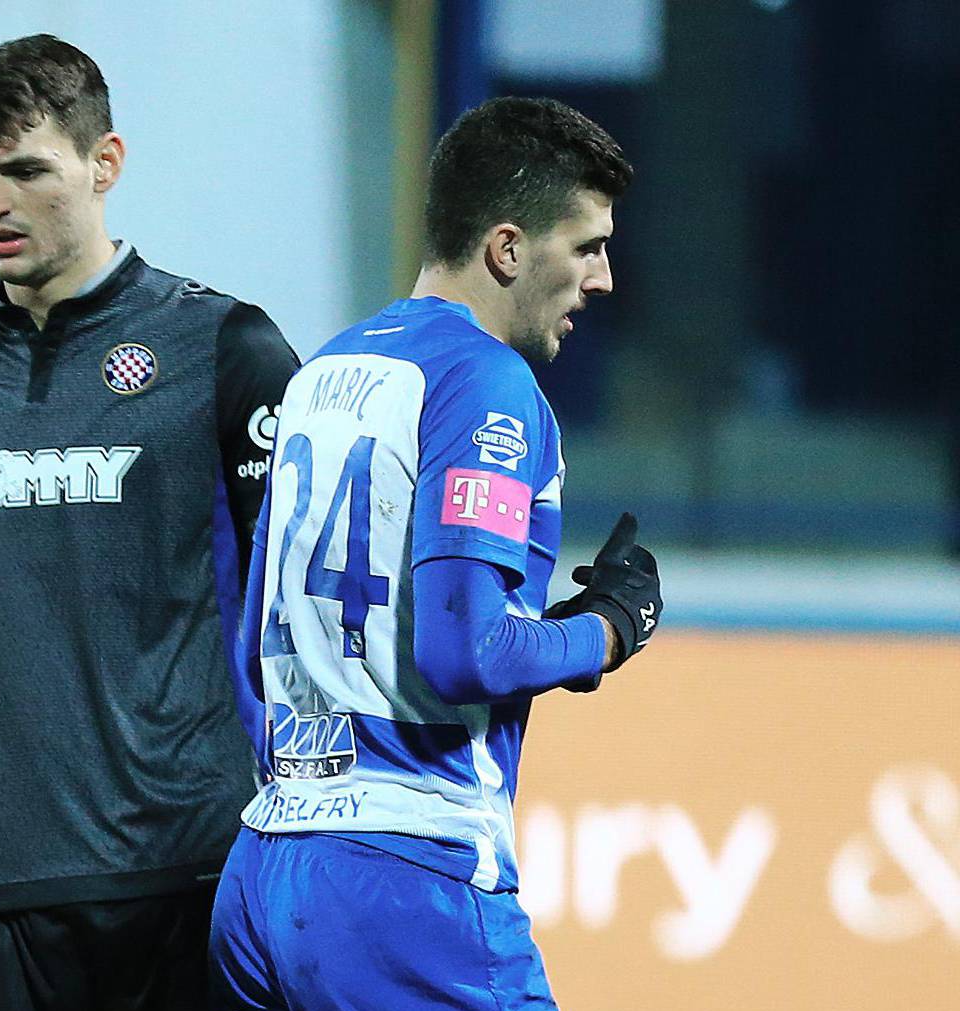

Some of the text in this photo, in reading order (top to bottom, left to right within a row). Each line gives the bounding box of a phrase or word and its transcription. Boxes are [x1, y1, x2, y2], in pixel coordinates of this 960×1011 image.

[306, 366, 391, 422] MARIĆ
[238, 455, 271, 481] otp
[263, 432, 389, 659] 24
